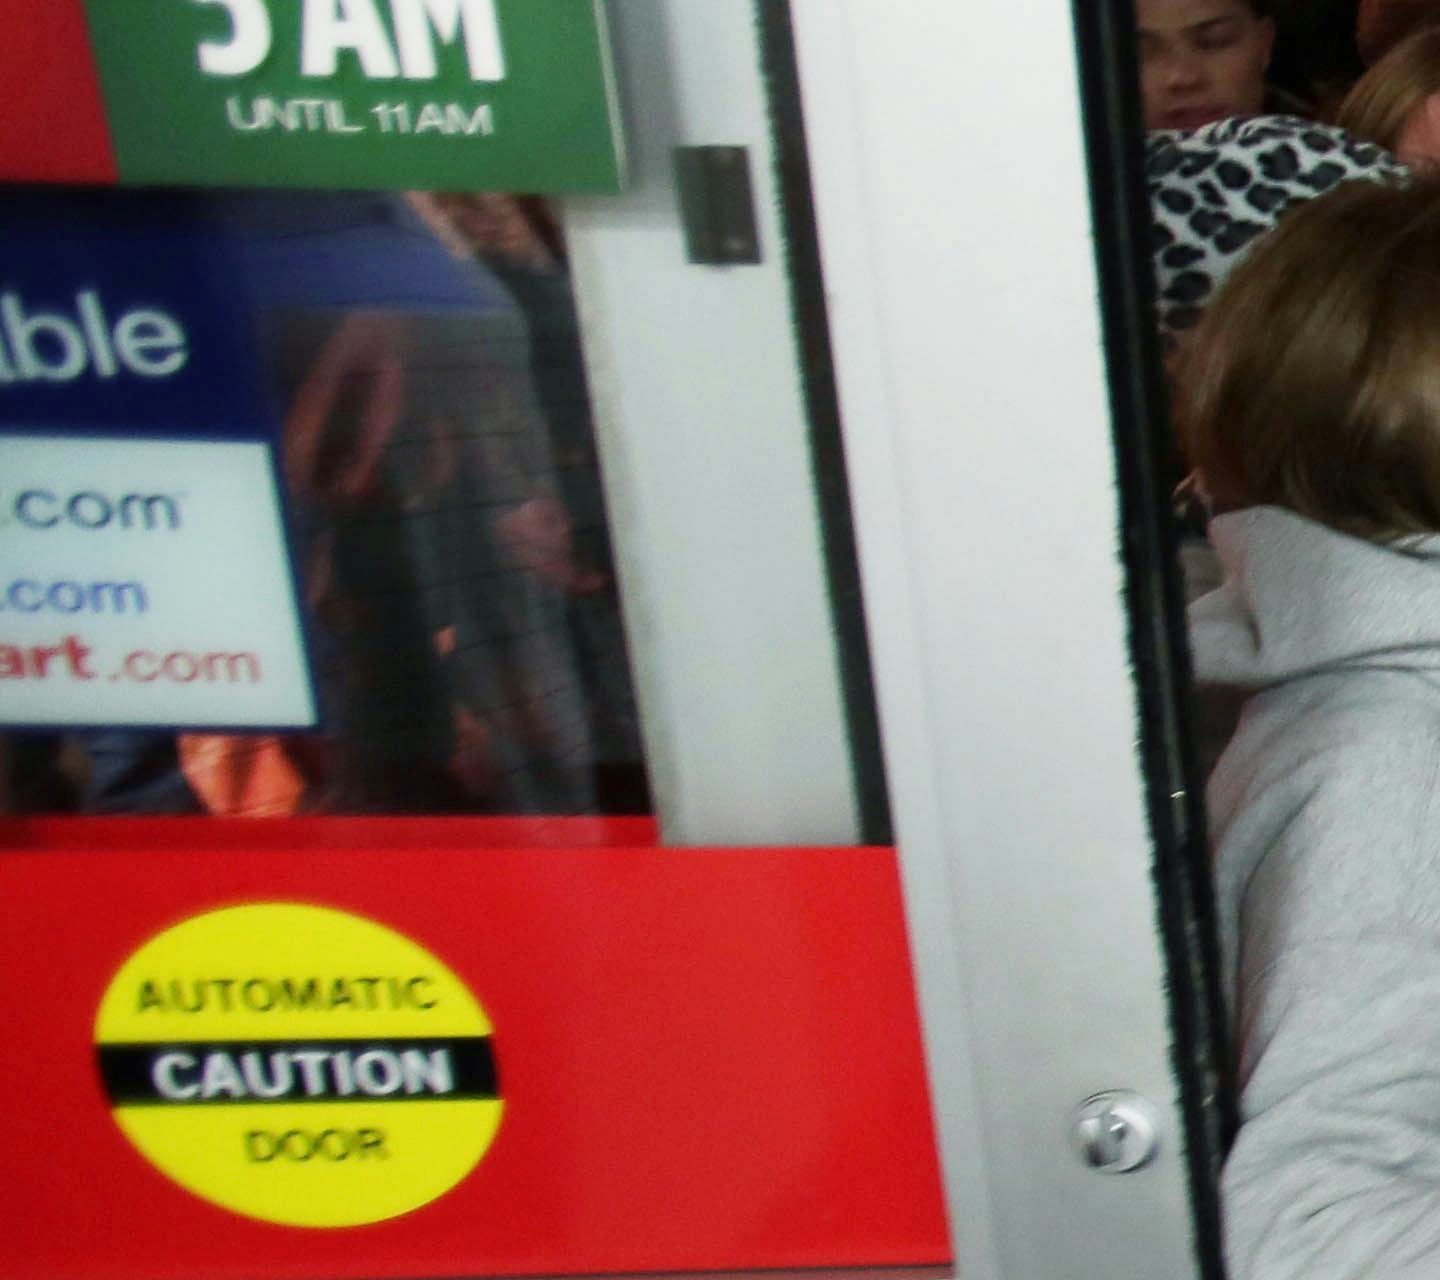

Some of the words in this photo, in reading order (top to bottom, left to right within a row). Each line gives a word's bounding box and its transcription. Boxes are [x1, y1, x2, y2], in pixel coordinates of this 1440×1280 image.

[226, 94, 362, 138] UNTIL
[0, 290, 188, 382] ble
[136, 974, 440, 1018] AUTOMATIC
[152, 1050, 454, 1102] CAUTION
[246, 1128, 390, 1166] DOOR
